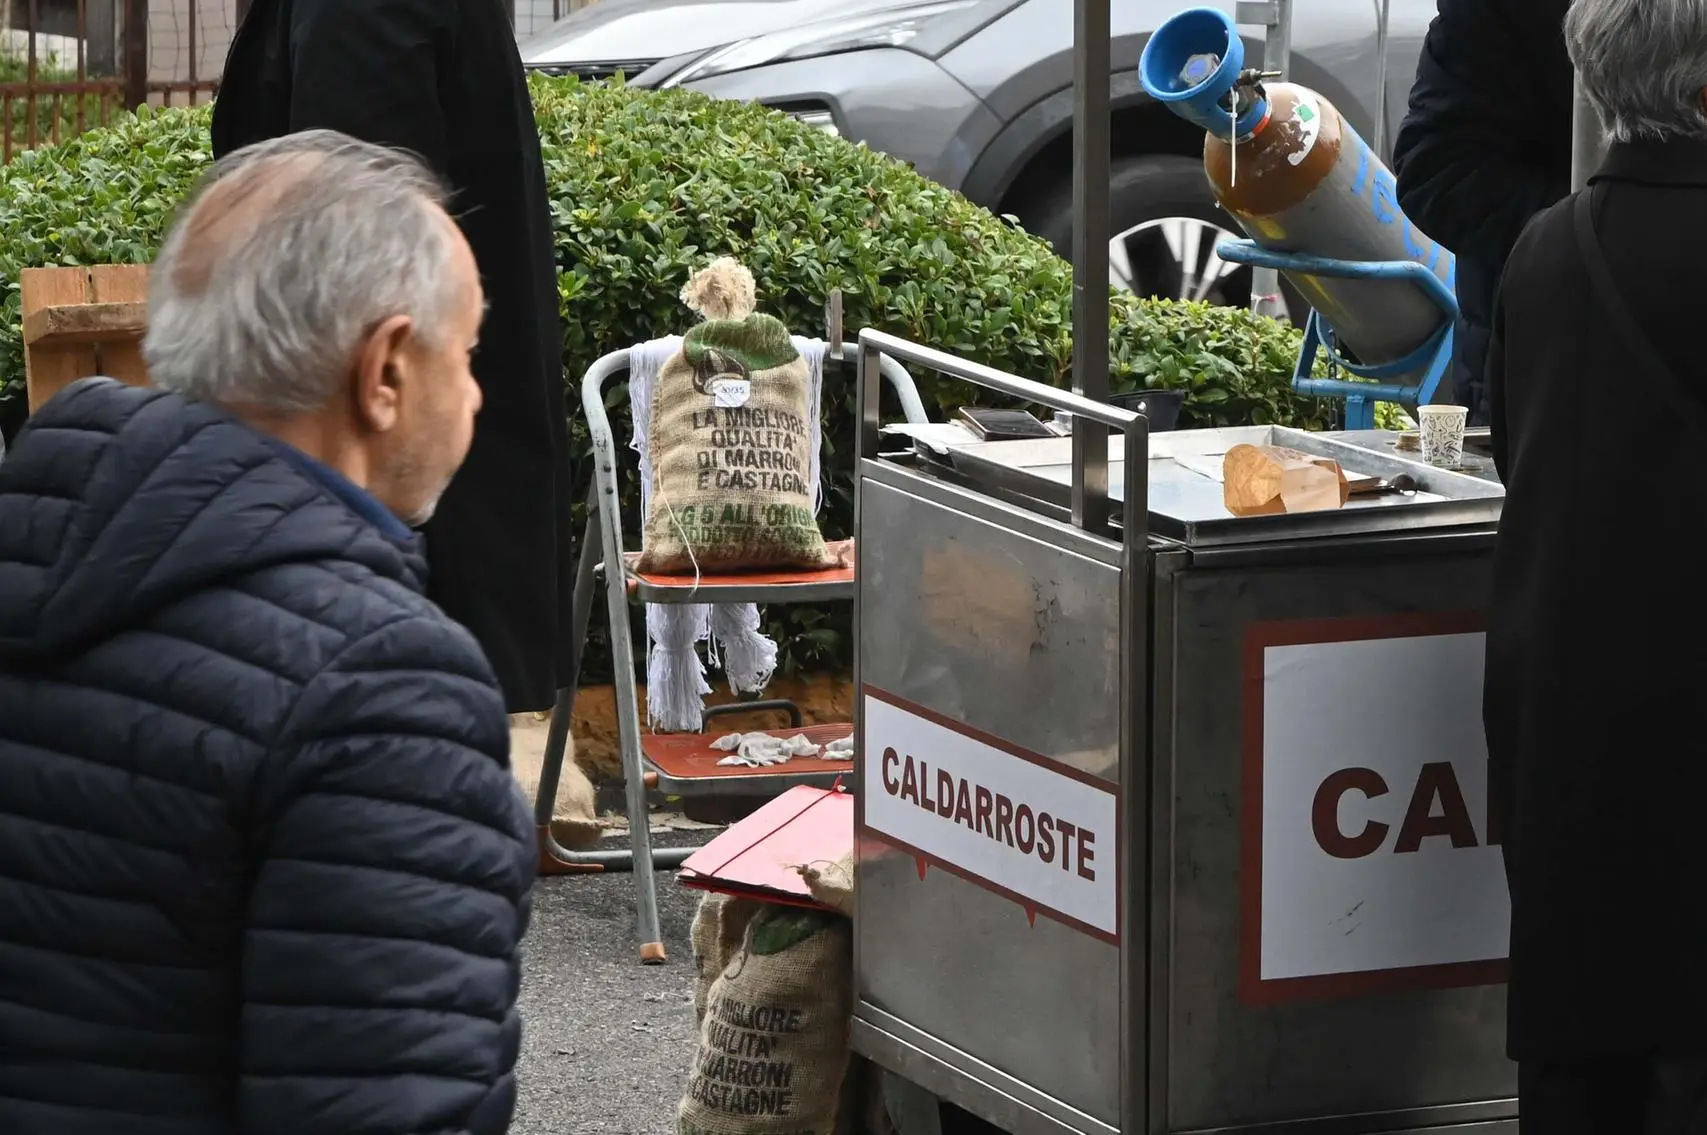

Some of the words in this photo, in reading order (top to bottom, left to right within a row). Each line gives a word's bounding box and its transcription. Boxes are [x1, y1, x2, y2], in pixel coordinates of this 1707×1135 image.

[692, 408, 718, 430] LA
[724, 406, 806, 439] MIGLIORE
[697, 450, 718, 469] DI
[697, 471, 710, 490] E
[882, 746, 1096, 882] CALDARROSTE
